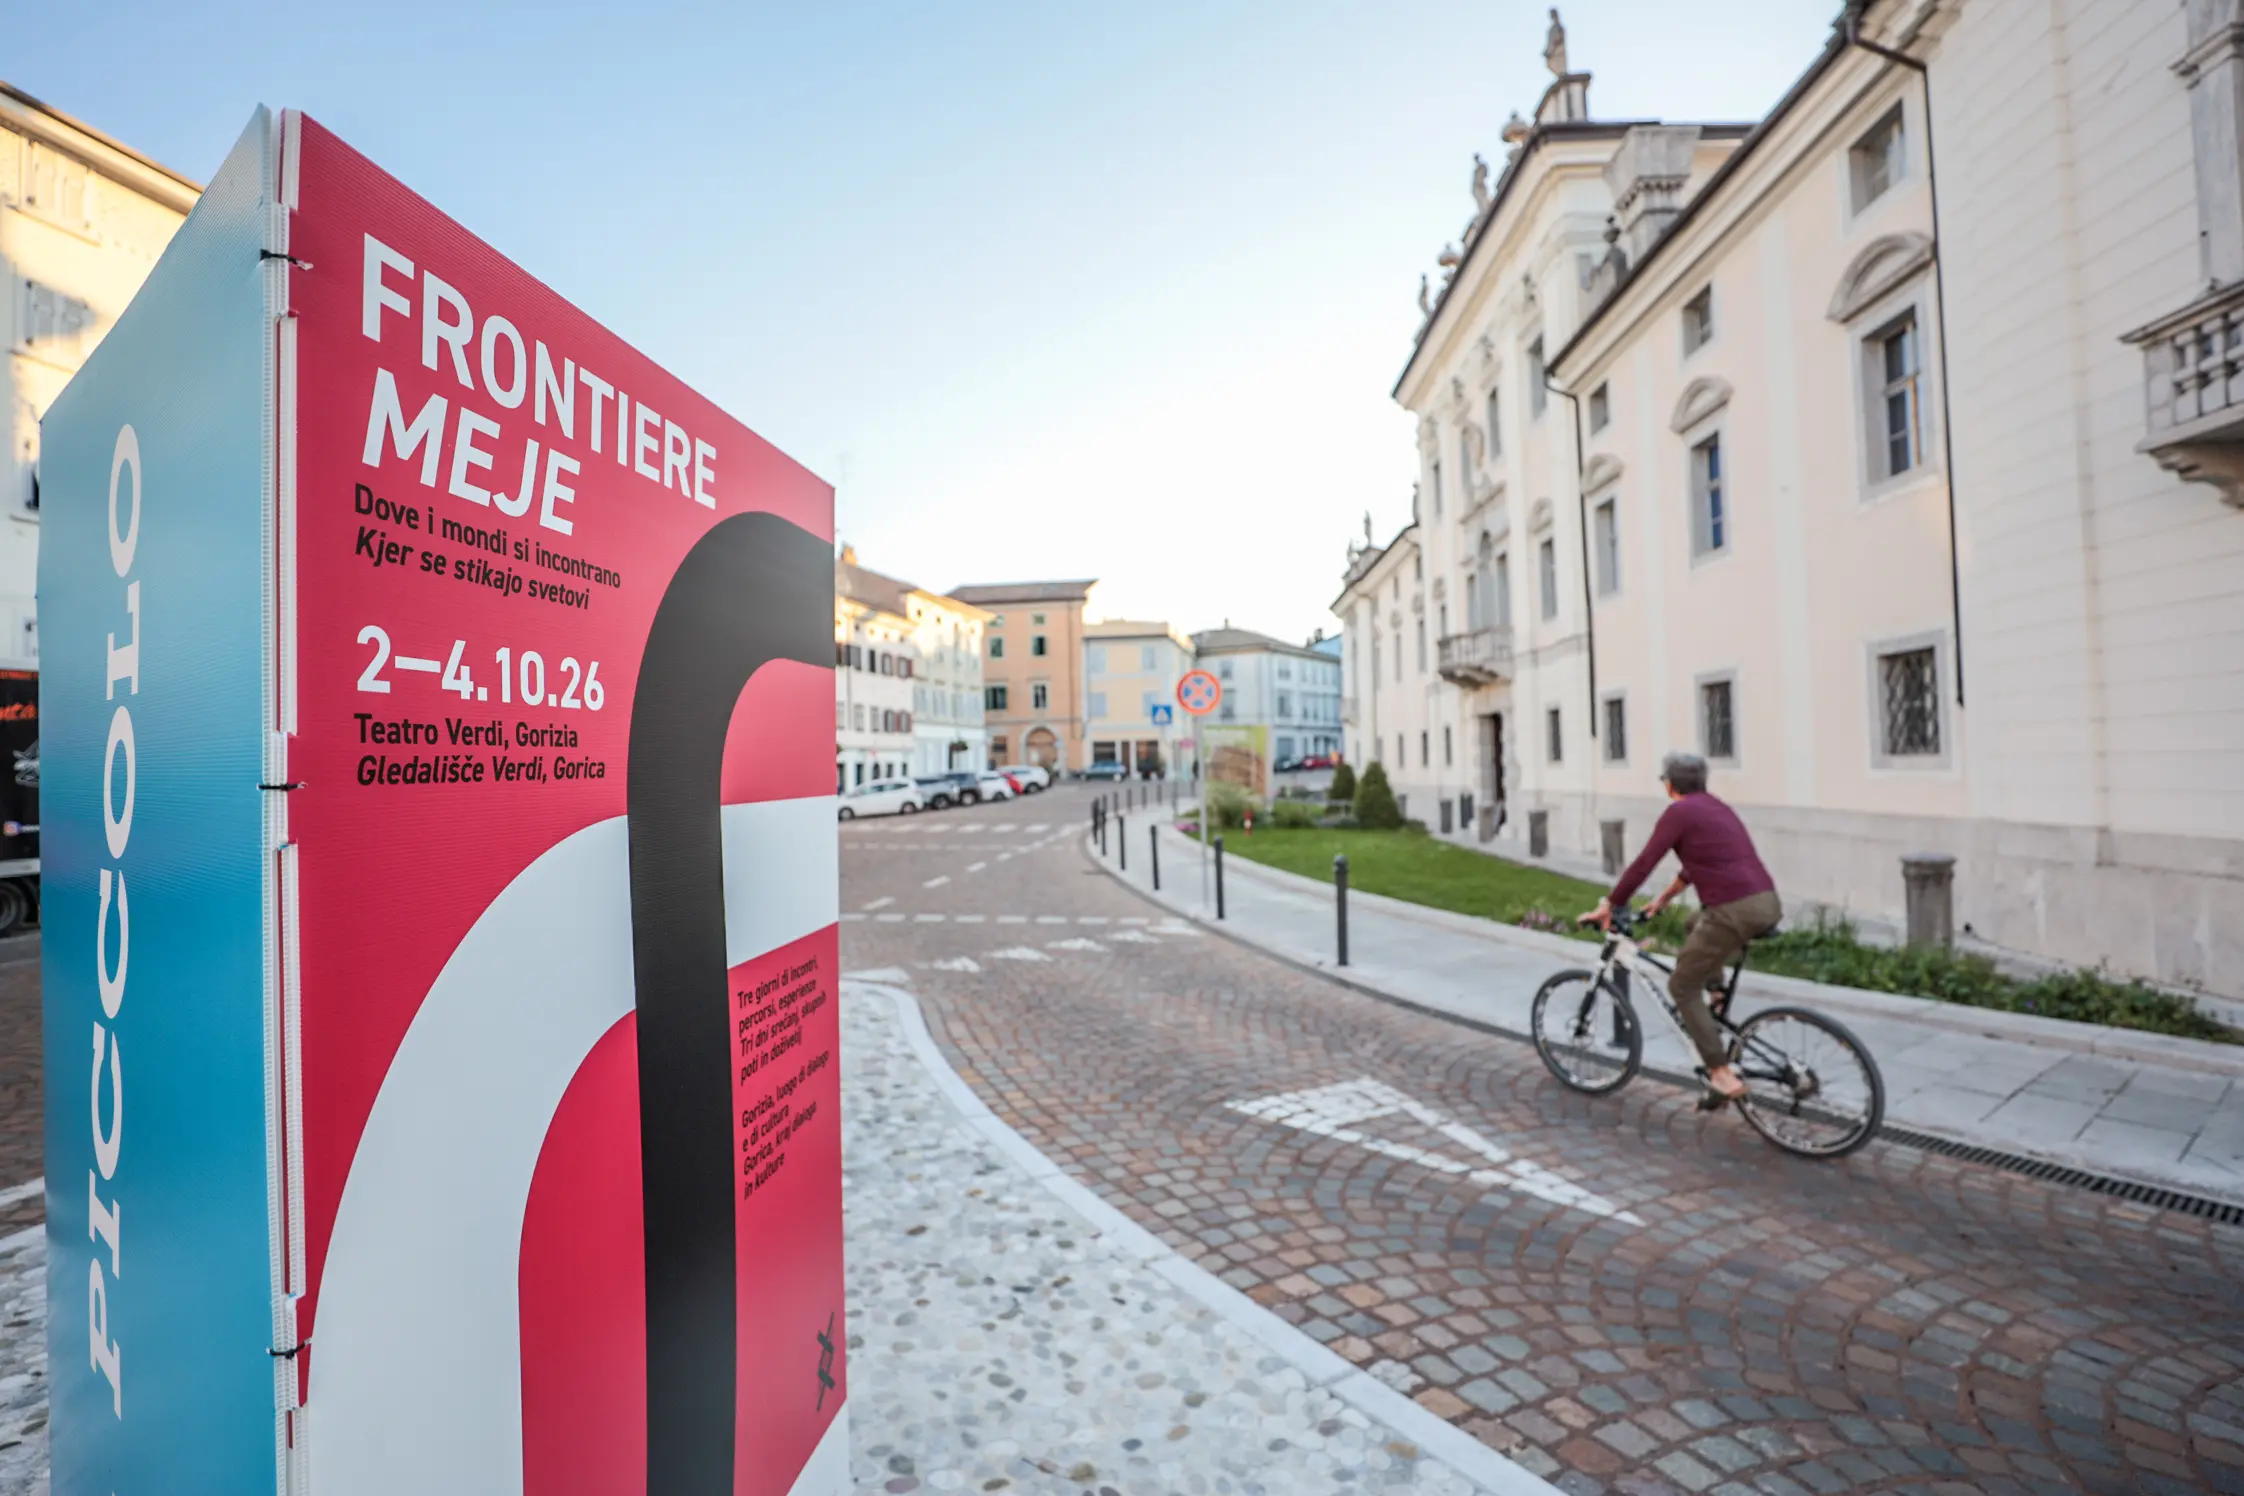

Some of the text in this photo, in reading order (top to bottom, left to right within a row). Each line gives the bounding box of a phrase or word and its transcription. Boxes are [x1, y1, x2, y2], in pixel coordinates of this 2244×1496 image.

[362, 232, 717, 510] FRONTIERE
[362, 367, 581, 536] MEJE
[355, 482, 621, 589] Dove i mondi si incontrano
[354, 525, 590, 610] Kjer se stikajo svetovi
[354, 712, 578, 750] Teatro Verdi, Gorizia
[357, 754, 606, 786] Gledališče Verdi, Gorica
[88, 424, 141, 1421] PICCOLO
[737, 990, 753, 1009] Tre
[755, 972, 780, 1004] giorni
[782, 968, 789, 987] di
[739, 979, 817, 1037] percorsi, esperienze
[741, 1033, 754, 1056] Tri
[755, 1023, 769, 1048] dni
[741, 1054, 759, 1087] poti
[760, 1048, 769, 1068] in
[742, 1094, 775, 1128] Gorizia,
[776, 1076, 798, 1101] luogo
[798, 1065, 806, 1084] di
[742, 1104, 789, 1153] e di cultura
[743, 1142, 774, 1176] Gorica,
[775, 1120, 791, 1146] kraj
[743, 1152, 785, 1201] in kulture
